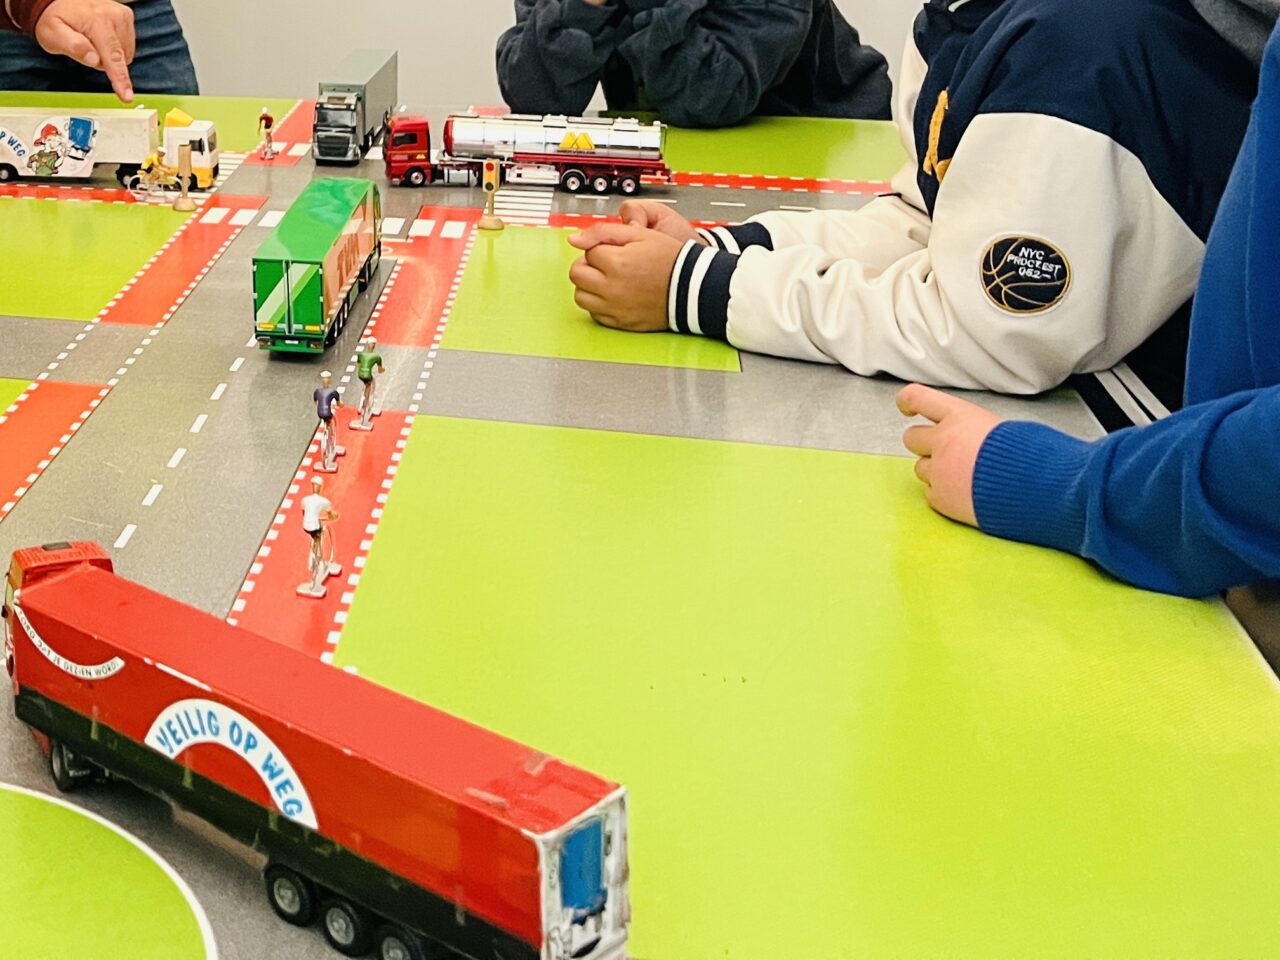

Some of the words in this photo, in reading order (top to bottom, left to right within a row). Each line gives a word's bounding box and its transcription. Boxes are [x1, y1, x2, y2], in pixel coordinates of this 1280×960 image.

[7, 135, 26, 157] WEG
[1018, 246, 1045, 260] NYC
[156, 708, 221, 754] VEILIG
[229, 720, 259, 754] OP
[261, 752, 304, 818] WEG
